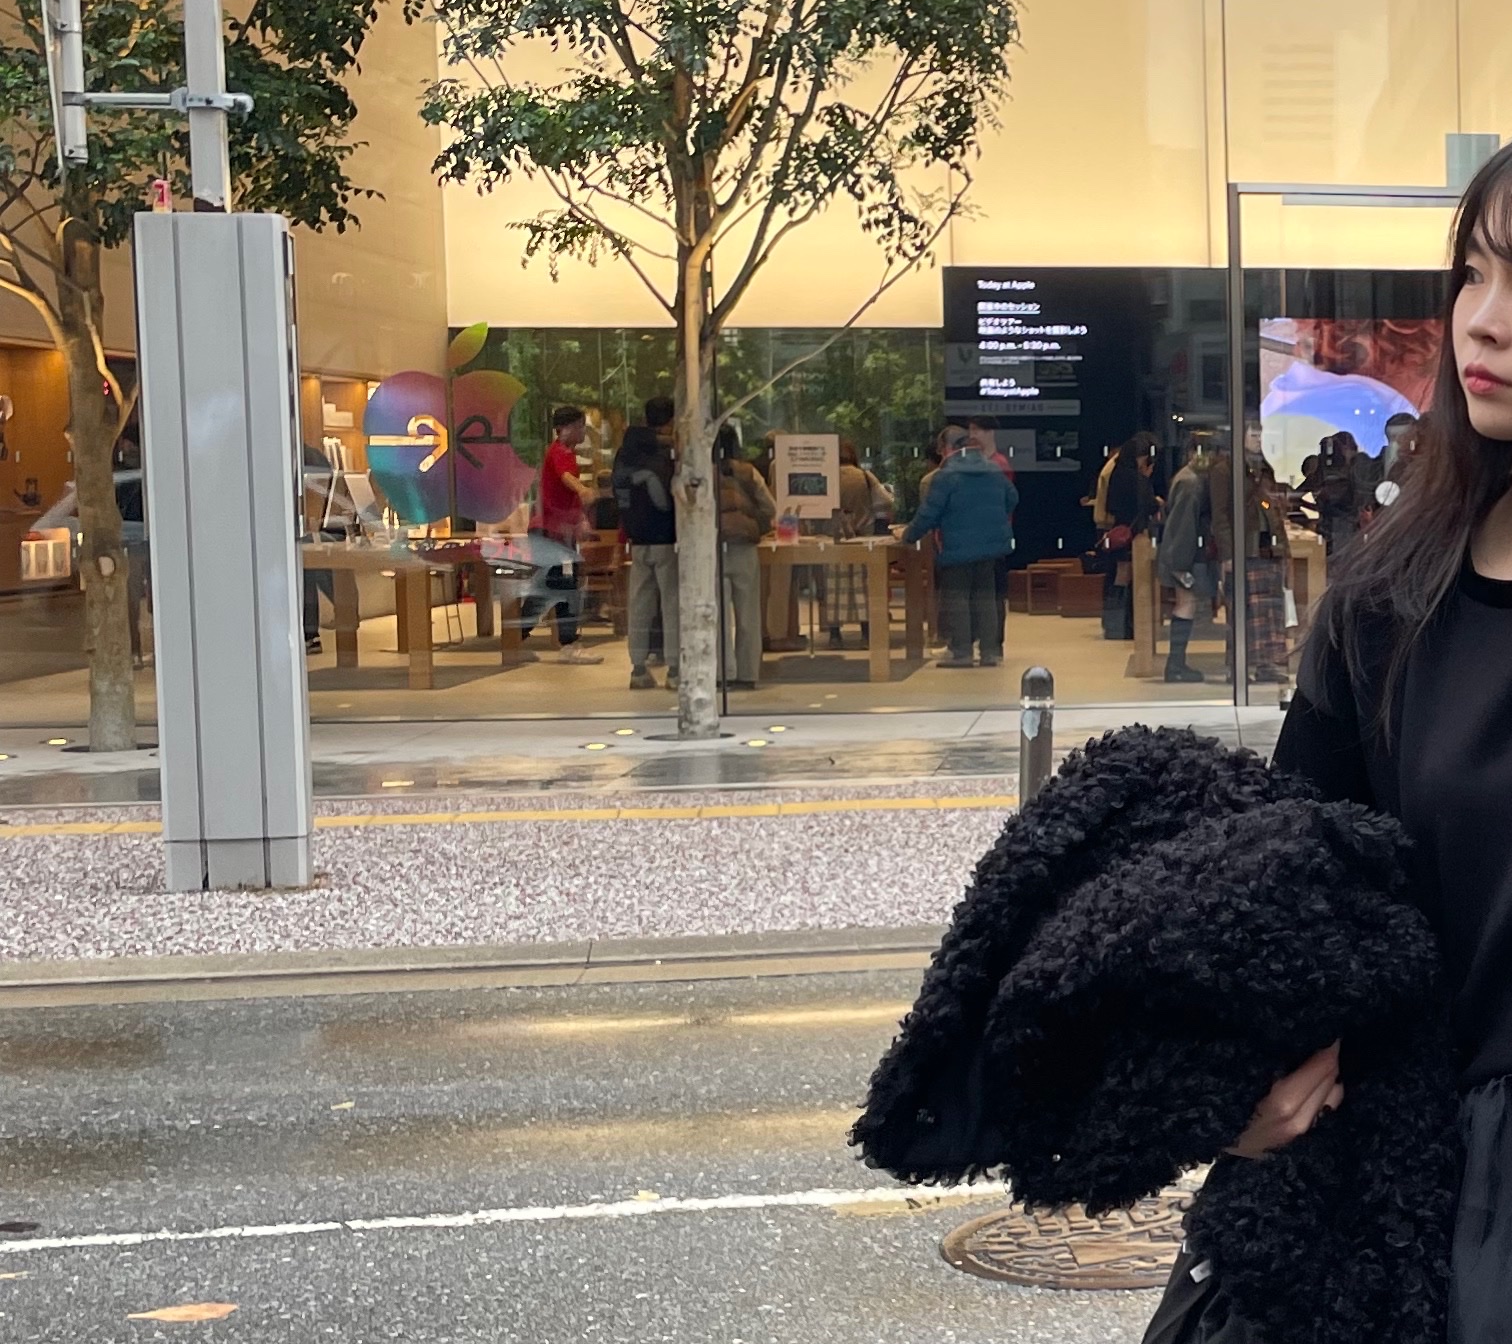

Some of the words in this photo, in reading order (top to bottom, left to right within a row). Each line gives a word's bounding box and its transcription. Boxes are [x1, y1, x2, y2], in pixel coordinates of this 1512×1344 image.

[977, 279, 1001, 291] Today
[1002, 281, 1011, 290] at
[1011, 280, 1036, 291] Apple
